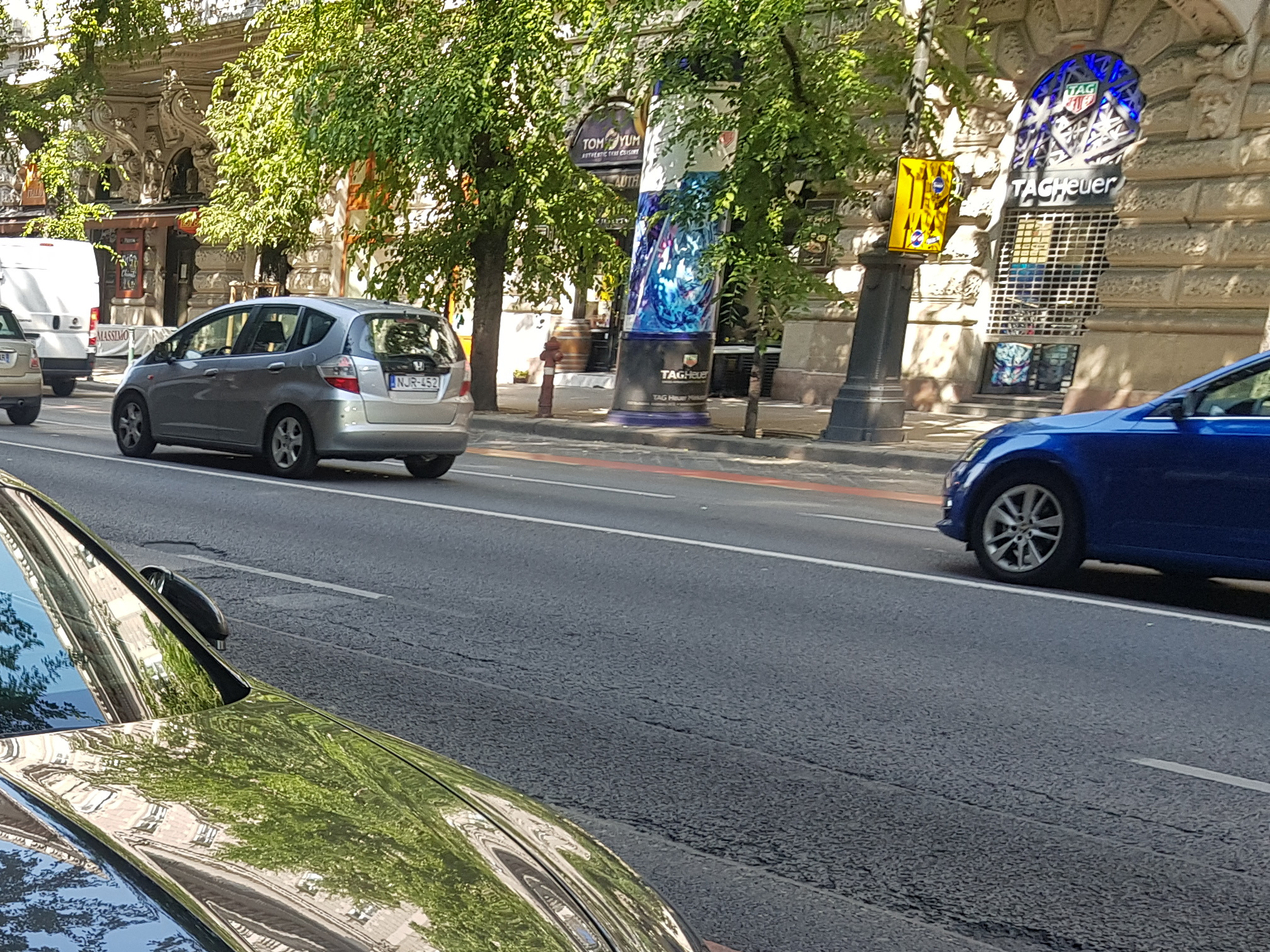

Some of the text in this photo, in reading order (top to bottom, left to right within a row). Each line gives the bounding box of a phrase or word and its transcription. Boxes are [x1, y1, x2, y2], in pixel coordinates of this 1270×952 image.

[1068, 84, 1095, 95] TAG
[583, 135, 641, 150] TOM YUM
[396, 377, 438, 388] NJR-452
